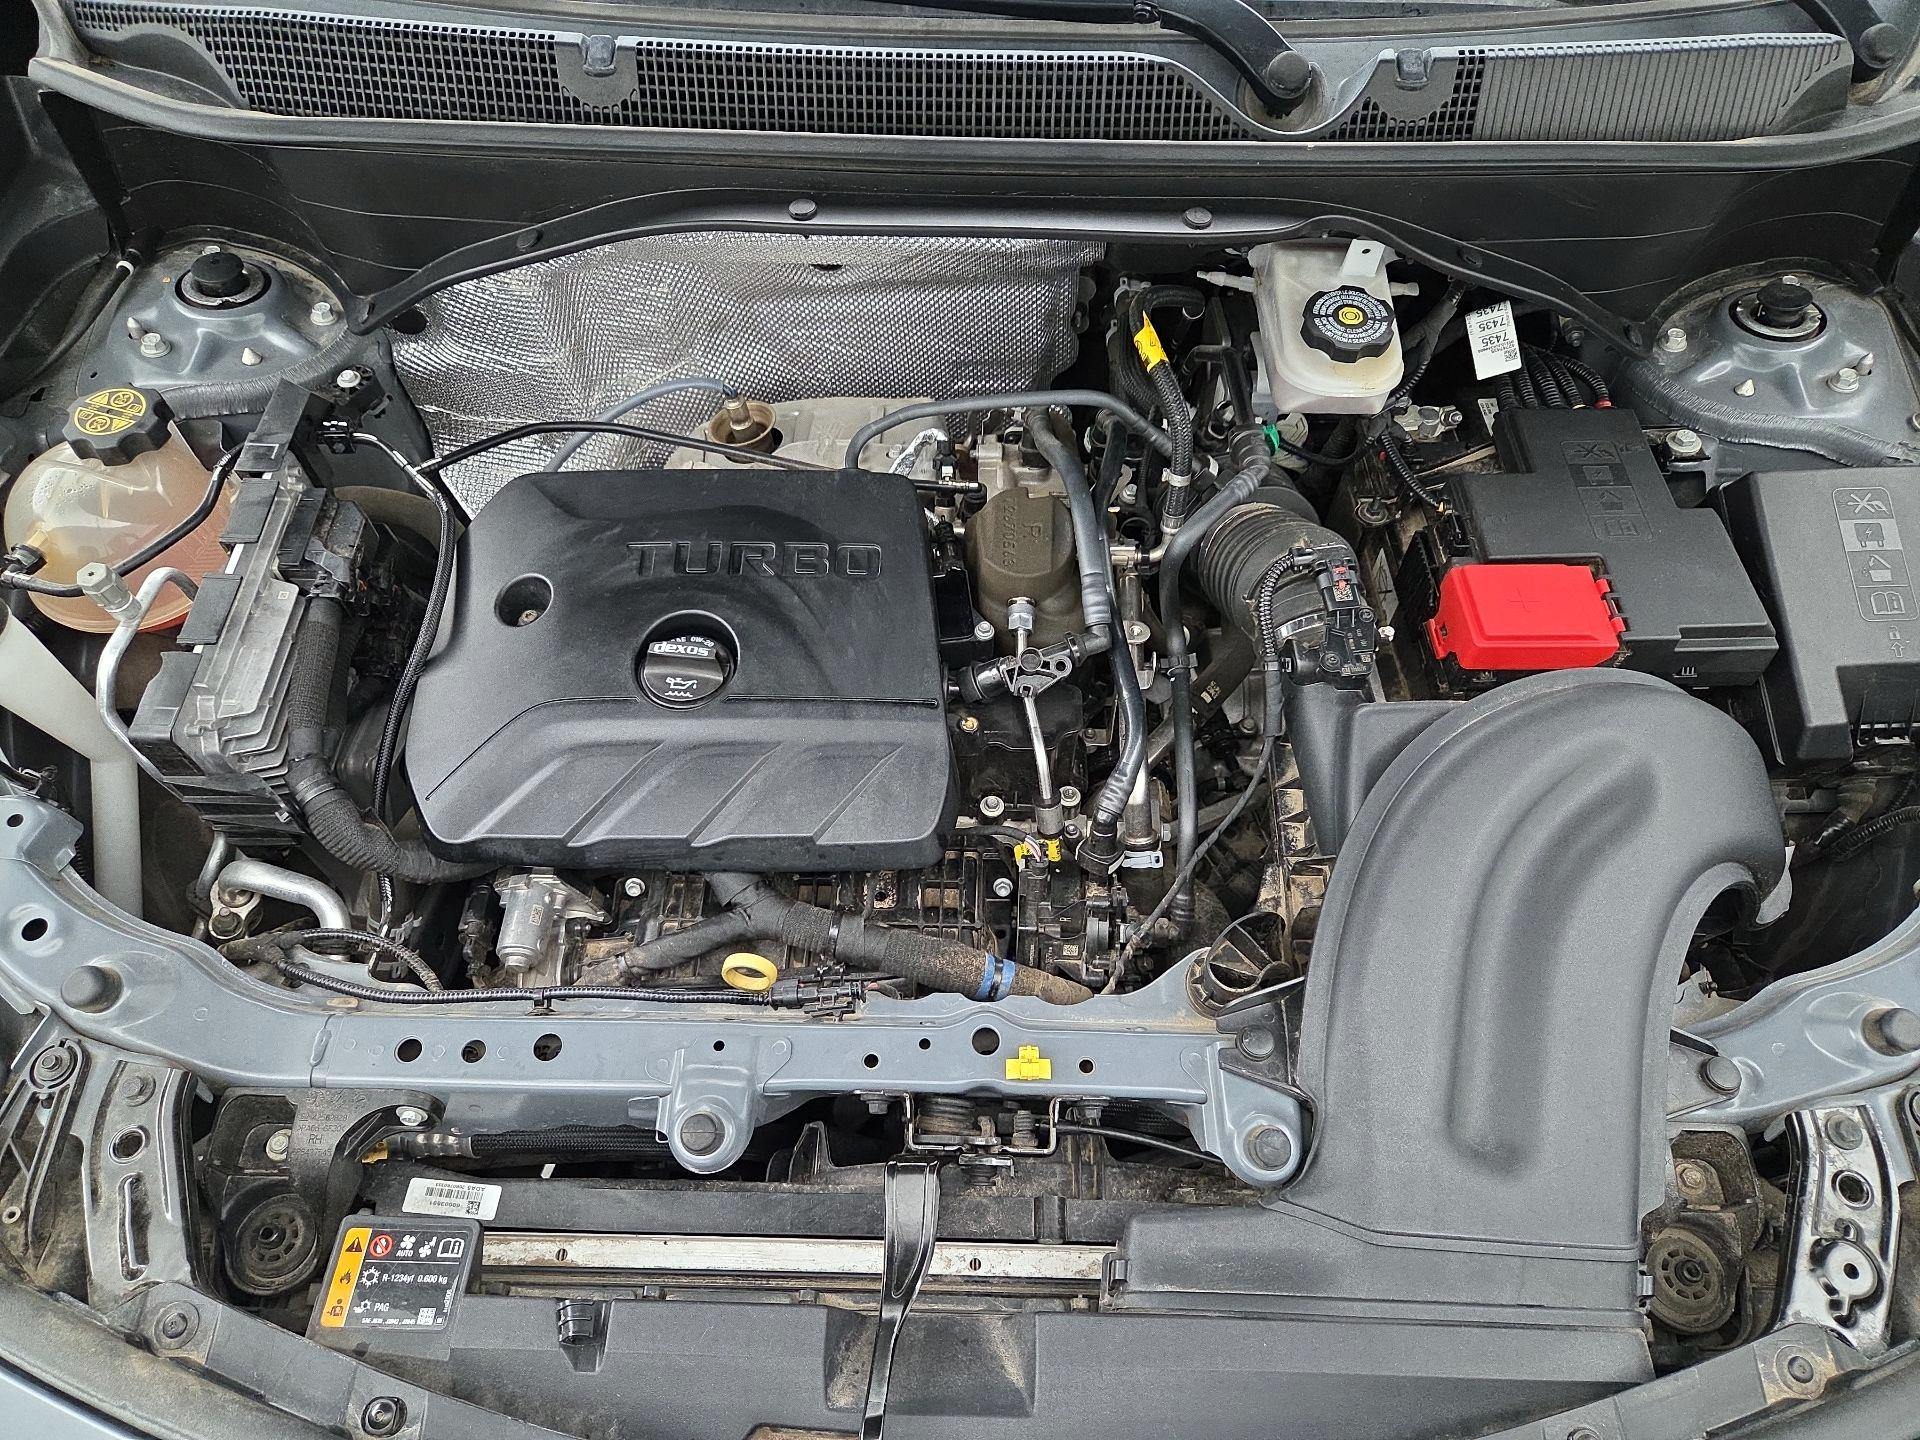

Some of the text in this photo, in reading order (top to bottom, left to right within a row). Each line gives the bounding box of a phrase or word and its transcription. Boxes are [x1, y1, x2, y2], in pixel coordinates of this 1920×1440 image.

[1479, 317, 1506, 332] 7435
[1482, 332, 1509, 347] 7435
[626, 541, 882, 577] TURBO
[690, 636, 714, 648] 0W-20
[653, 641, 709, 657] dexos
[308, 1133, 323, 1145] RH
[396, 1249, 414, 1257] AUTO
[381, 1274, 448, 1284] R-1234yf 0.600 kg
[374, 1302, 390, 1312] PAG
